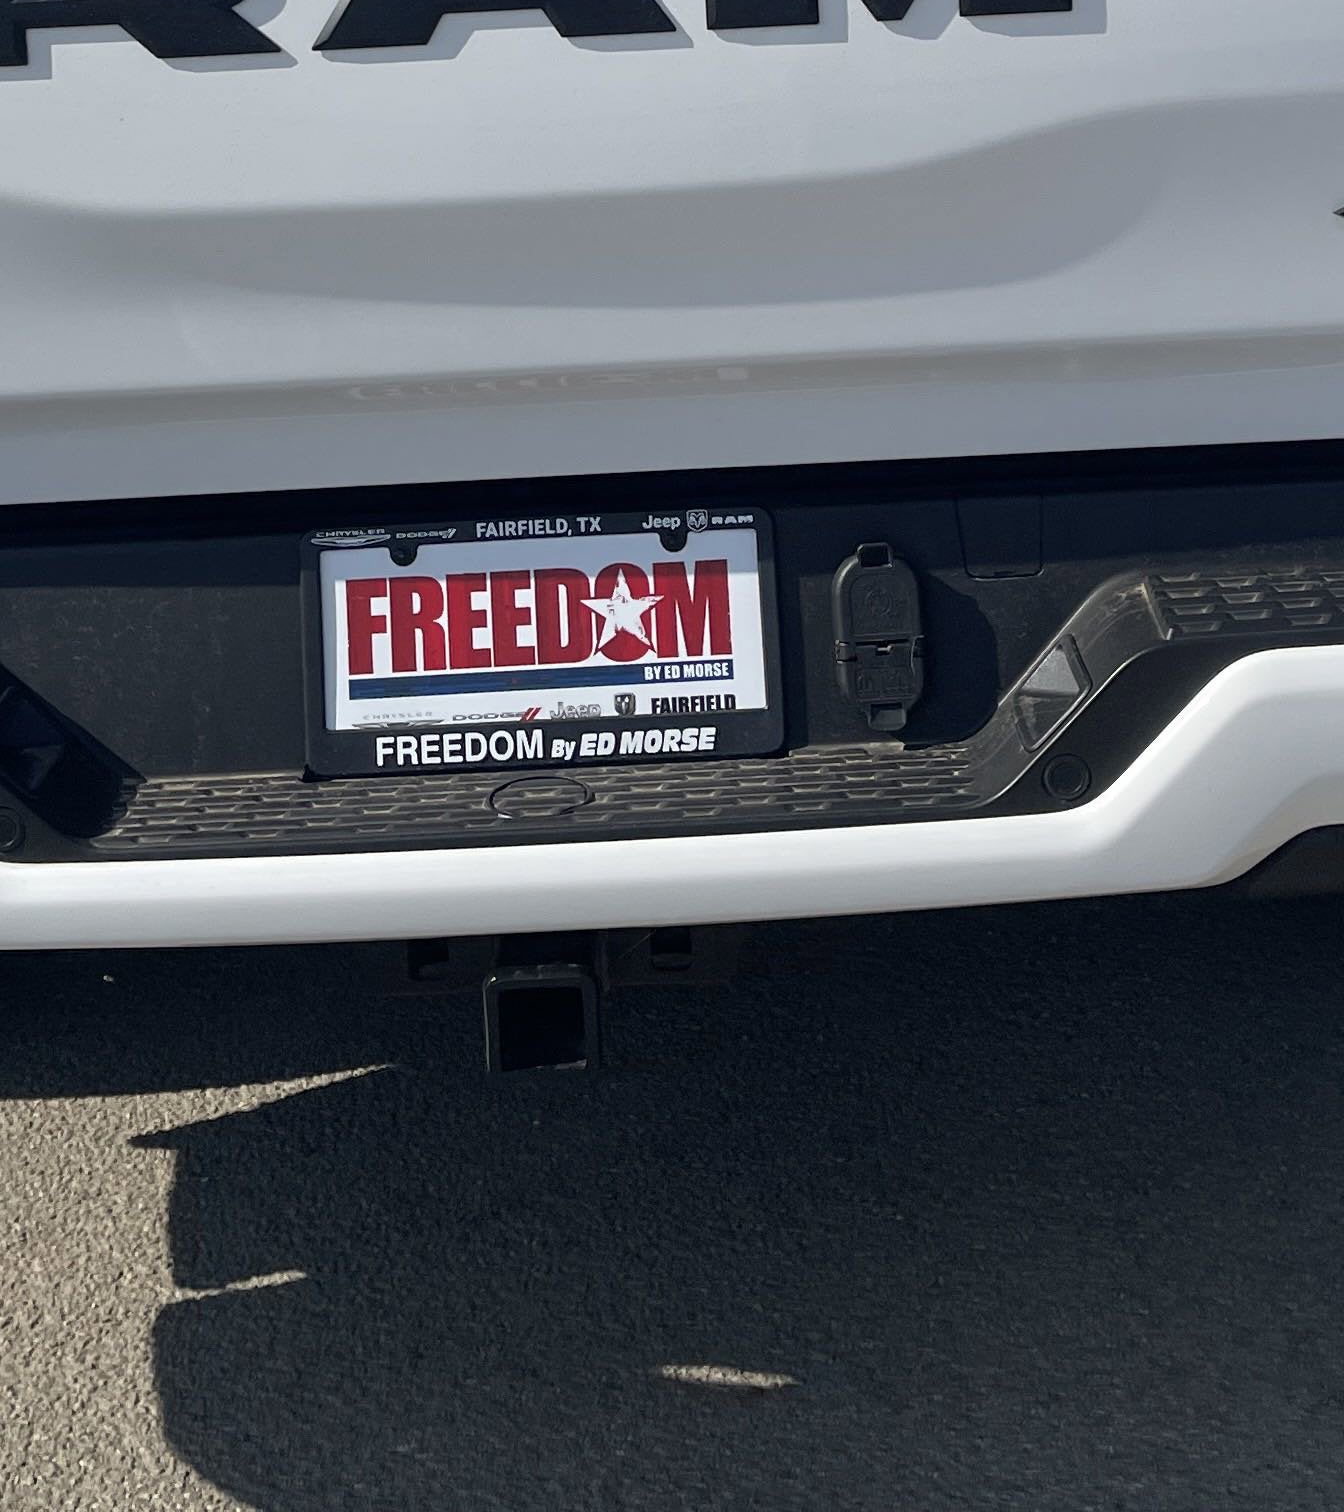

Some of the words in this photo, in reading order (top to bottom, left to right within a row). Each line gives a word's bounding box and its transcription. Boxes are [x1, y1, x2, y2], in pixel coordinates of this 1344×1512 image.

[475, 518, 572, 538] FAIRFIELD,
[576, 516, 602, 533] TX
[642, 514, 681, 530] Jeep
[711, 514, 754, 525] RAM
[345, 559, 733, 675] FREEDOM
[644, 665, 661, 681] BY
[664, 664, 680, 679] ED
[683, 662, 730, 679] MORSE
[650, 693, 737, 715] FAIRFIELD
[375, 728, 544, 767] FREEDOM
[551, 738, 576, 761] By
[579, 732, 616, 758] ED
[618, 726, 717, 755] MORSE
